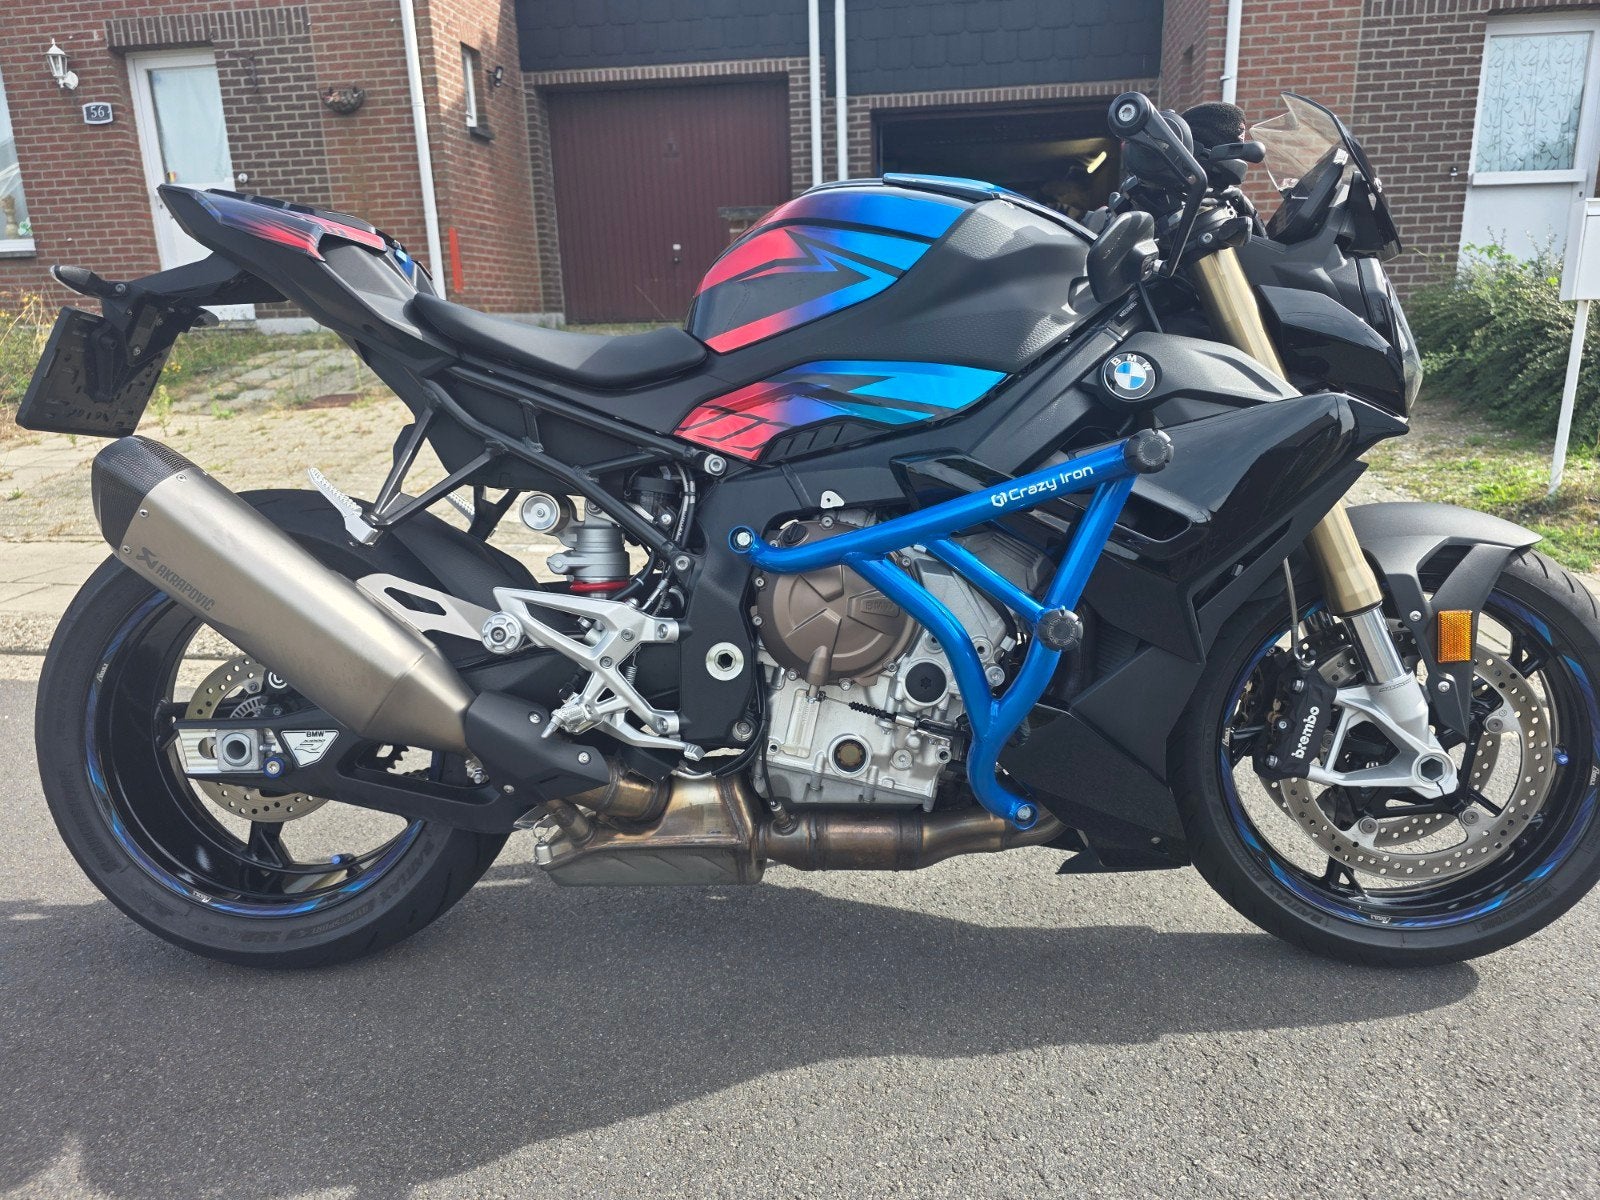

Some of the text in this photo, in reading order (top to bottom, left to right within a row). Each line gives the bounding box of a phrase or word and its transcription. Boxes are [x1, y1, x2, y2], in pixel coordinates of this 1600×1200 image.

[90, 105, 105, 118] 56
[1110, 353, 1153, 371] BMW
[1008, 466, 1094, 501] Crazy Iron
[1291, 706, 1320, 759] brembo
